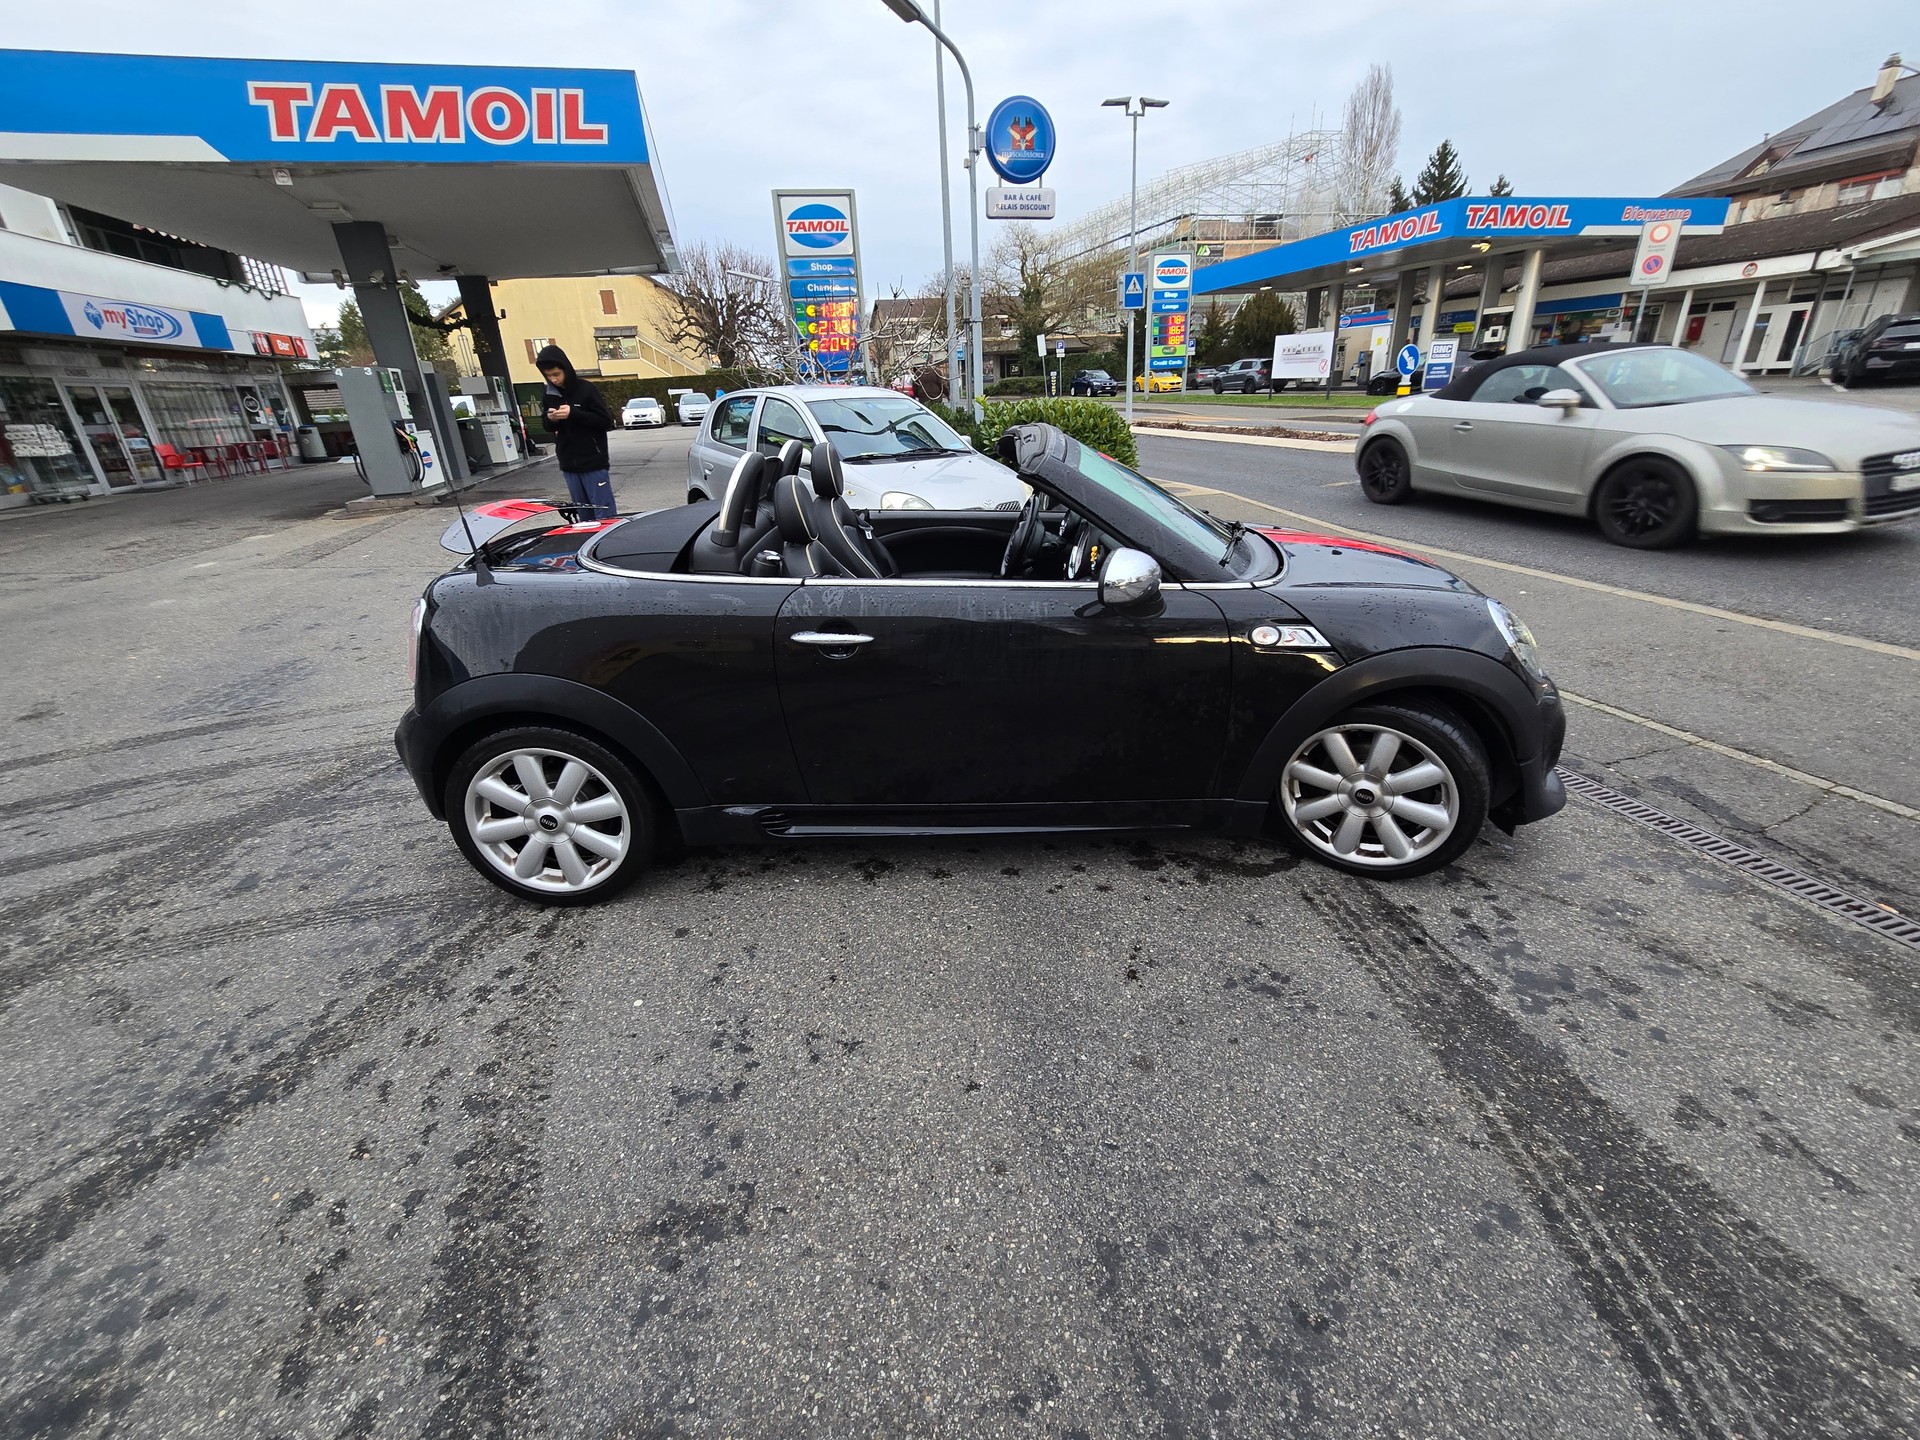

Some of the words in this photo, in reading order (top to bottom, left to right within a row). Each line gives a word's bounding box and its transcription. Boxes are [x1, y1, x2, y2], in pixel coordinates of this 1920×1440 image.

[247, 81, 608, 145] TAMOIL
[1018, 192, 1024, 201] À
[1025, 192, 1042, 201] CAFÉ
[1019, 203, 1051, 211] DISCOUNT
[1621, 205, 1692, 221] Bienvenue
[1466, 204, 1571, 229] TAMOIL
[786, 220, 850, 233] TAMOIL
[1349, 210, 1442, 253] TAMOIL
[810, 262, 833, 273] Shop
[102, 307, 164, 332] myShop
[277, 338, 290, 351] Bar
[1433, 345, 1452, 354] BNC
[335, 368, 343, 376] 4
[363, 367, 372, 375] 3
